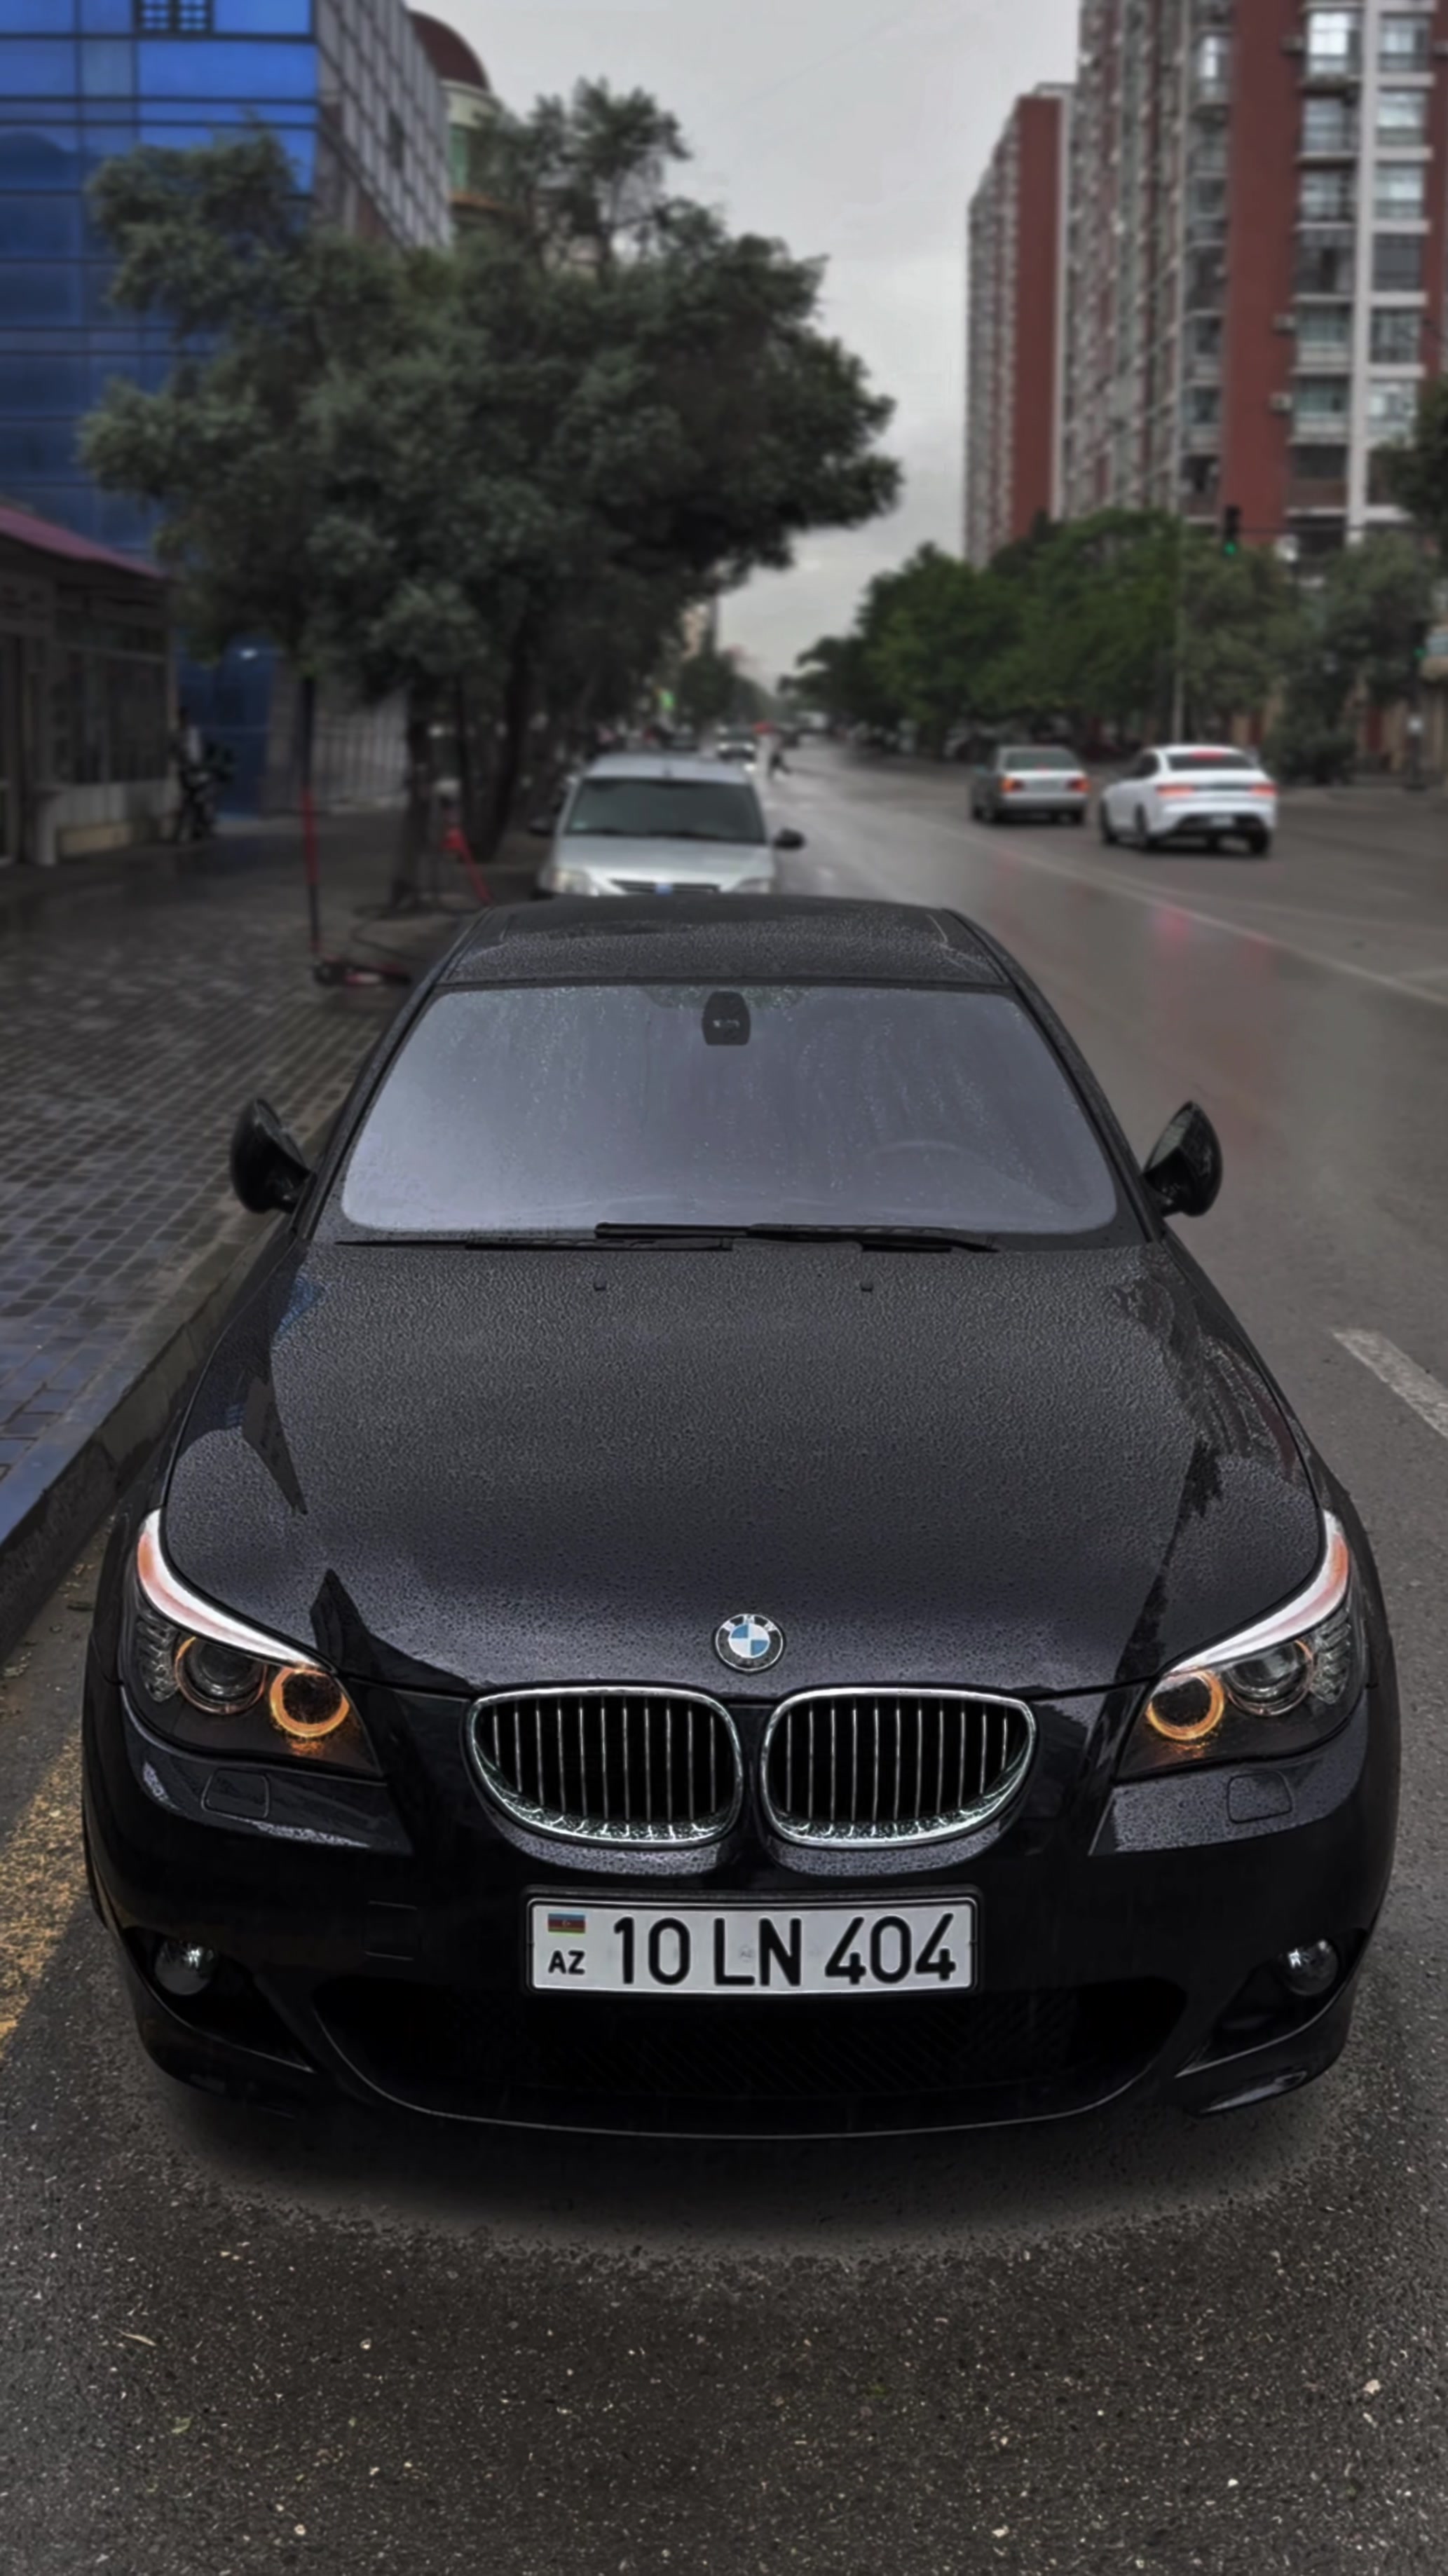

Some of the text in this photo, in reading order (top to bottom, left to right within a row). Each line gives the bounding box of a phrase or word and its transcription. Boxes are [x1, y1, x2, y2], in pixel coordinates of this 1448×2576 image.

[548, 1951, 585, 1975] AZ
[614, 1913, 956, 1987] 10 LN 404
